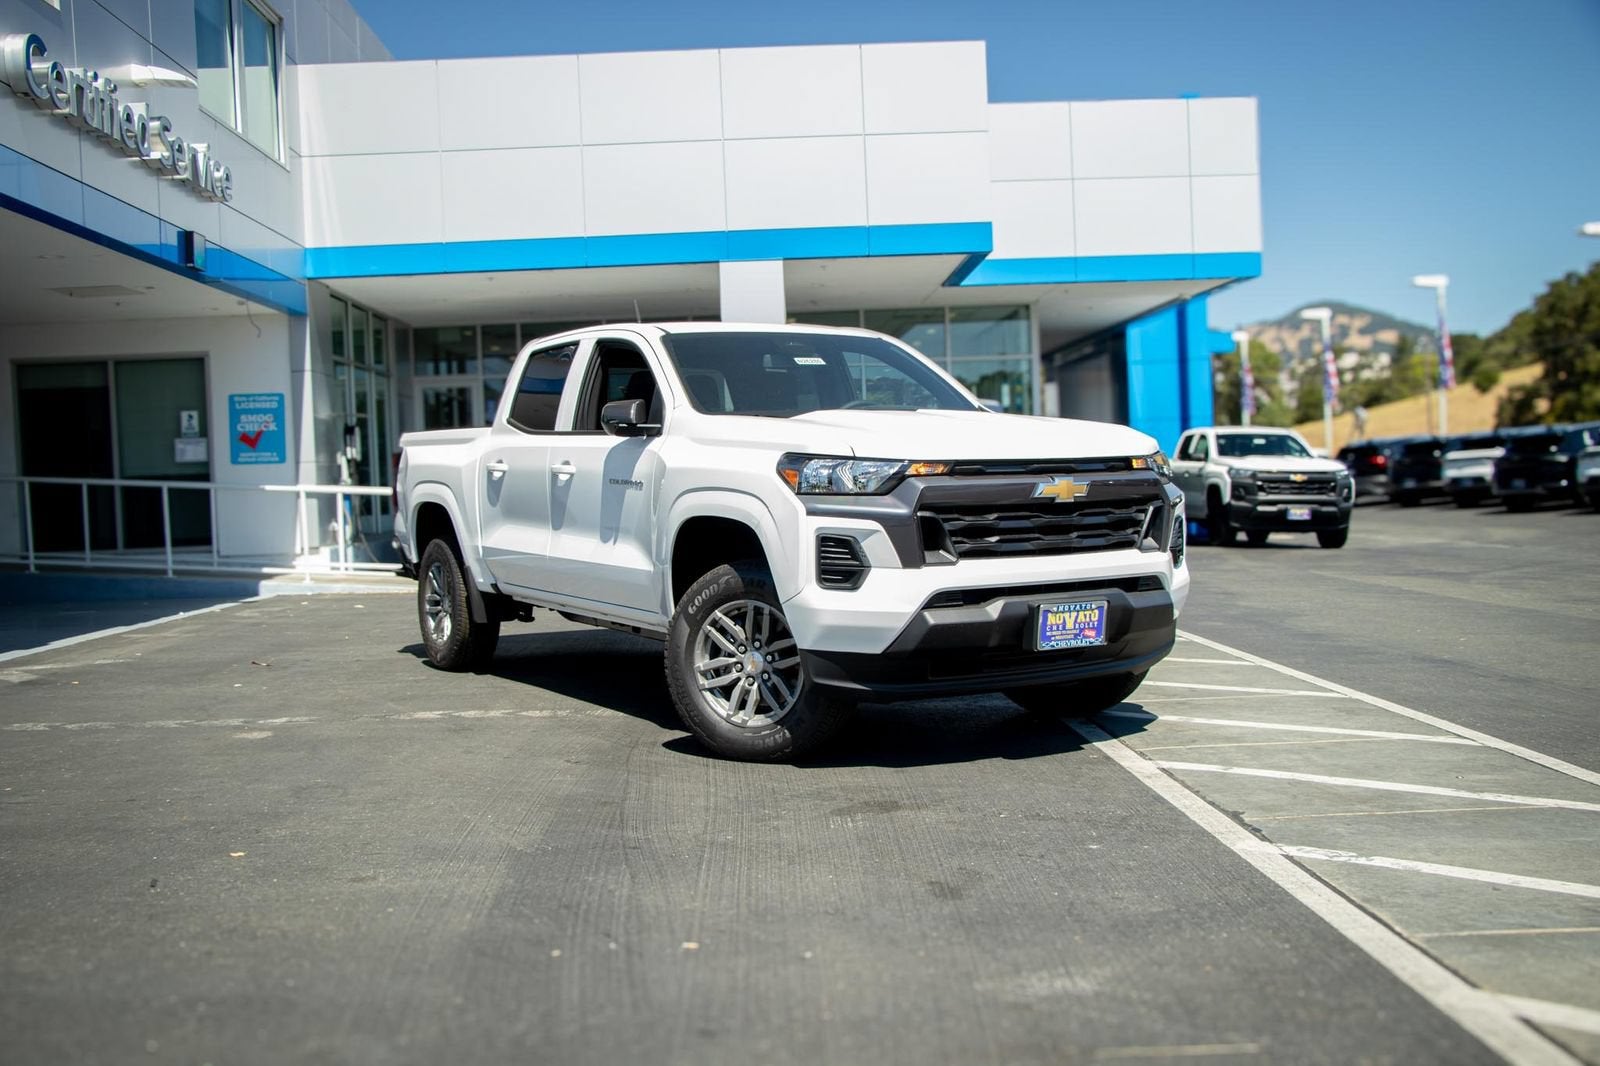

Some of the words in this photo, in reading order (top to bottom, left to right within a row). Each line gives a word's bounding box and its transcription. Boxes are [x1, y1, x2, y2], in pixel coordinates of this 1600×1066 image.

[241, 414, 274, 422] SMOG
[236, 422, 278, 431] CHECK
[1047, 609, 1099, 629] NOVATO
